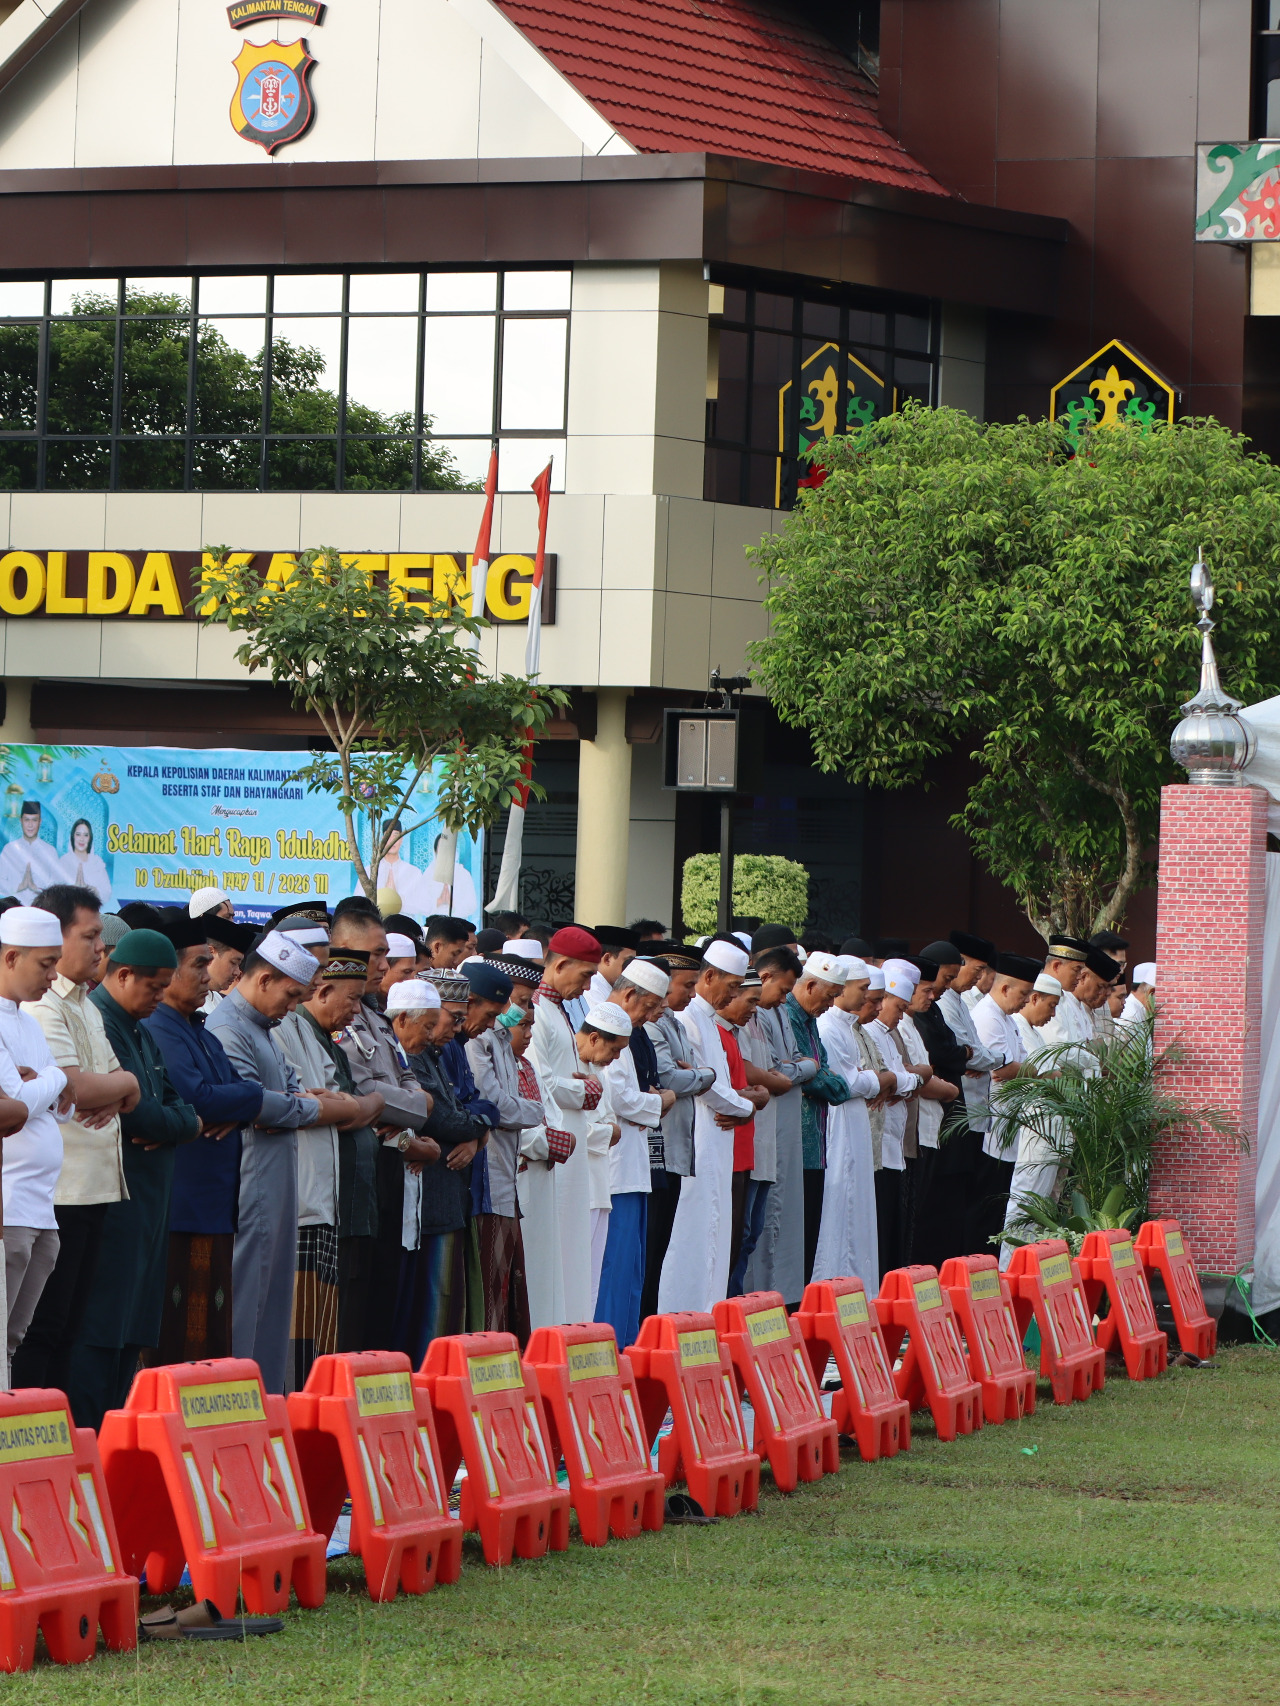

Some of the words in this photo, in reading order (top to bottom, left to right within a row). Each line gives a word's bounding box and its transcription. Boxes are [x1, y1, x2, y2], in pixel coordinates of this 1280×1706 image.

[231, 0, 281, 20] KALIMANTAN
[283, 0, 316, 16] TENGAH
[127, 765, 159, 778] KEPALA
[162, 766, 209, 780] KEPOLISIAN
[212, 768, 245, 781] DAERAH
[162, 784, 198, 797] BESERTA
[201, 785, 221, 797] STAF
[224, 786, 241, 798] DAN
[244, 787, 303, 800] BHAYANGKARI
[210, 804, 258, 818] Mengucapkan
[107, 824, 177, 855] Selamat
[181, 826, 223, 857] Hari
[226, 827, 271, 865] Raya
[135, 868, 148, 887] 10
[223, 871, 250, 892] 1447
[253, 871, 265, 892] H
[268, 872, 276, 894] /
[278, 873, 310, 893] 2026
[313, 873, 329, 894] M
[190, 1393, 232, 1415] KORLANTAS
[232, 1392, 251, 1410] POLRI
[35, 1424, 58, 1445] POLRI
